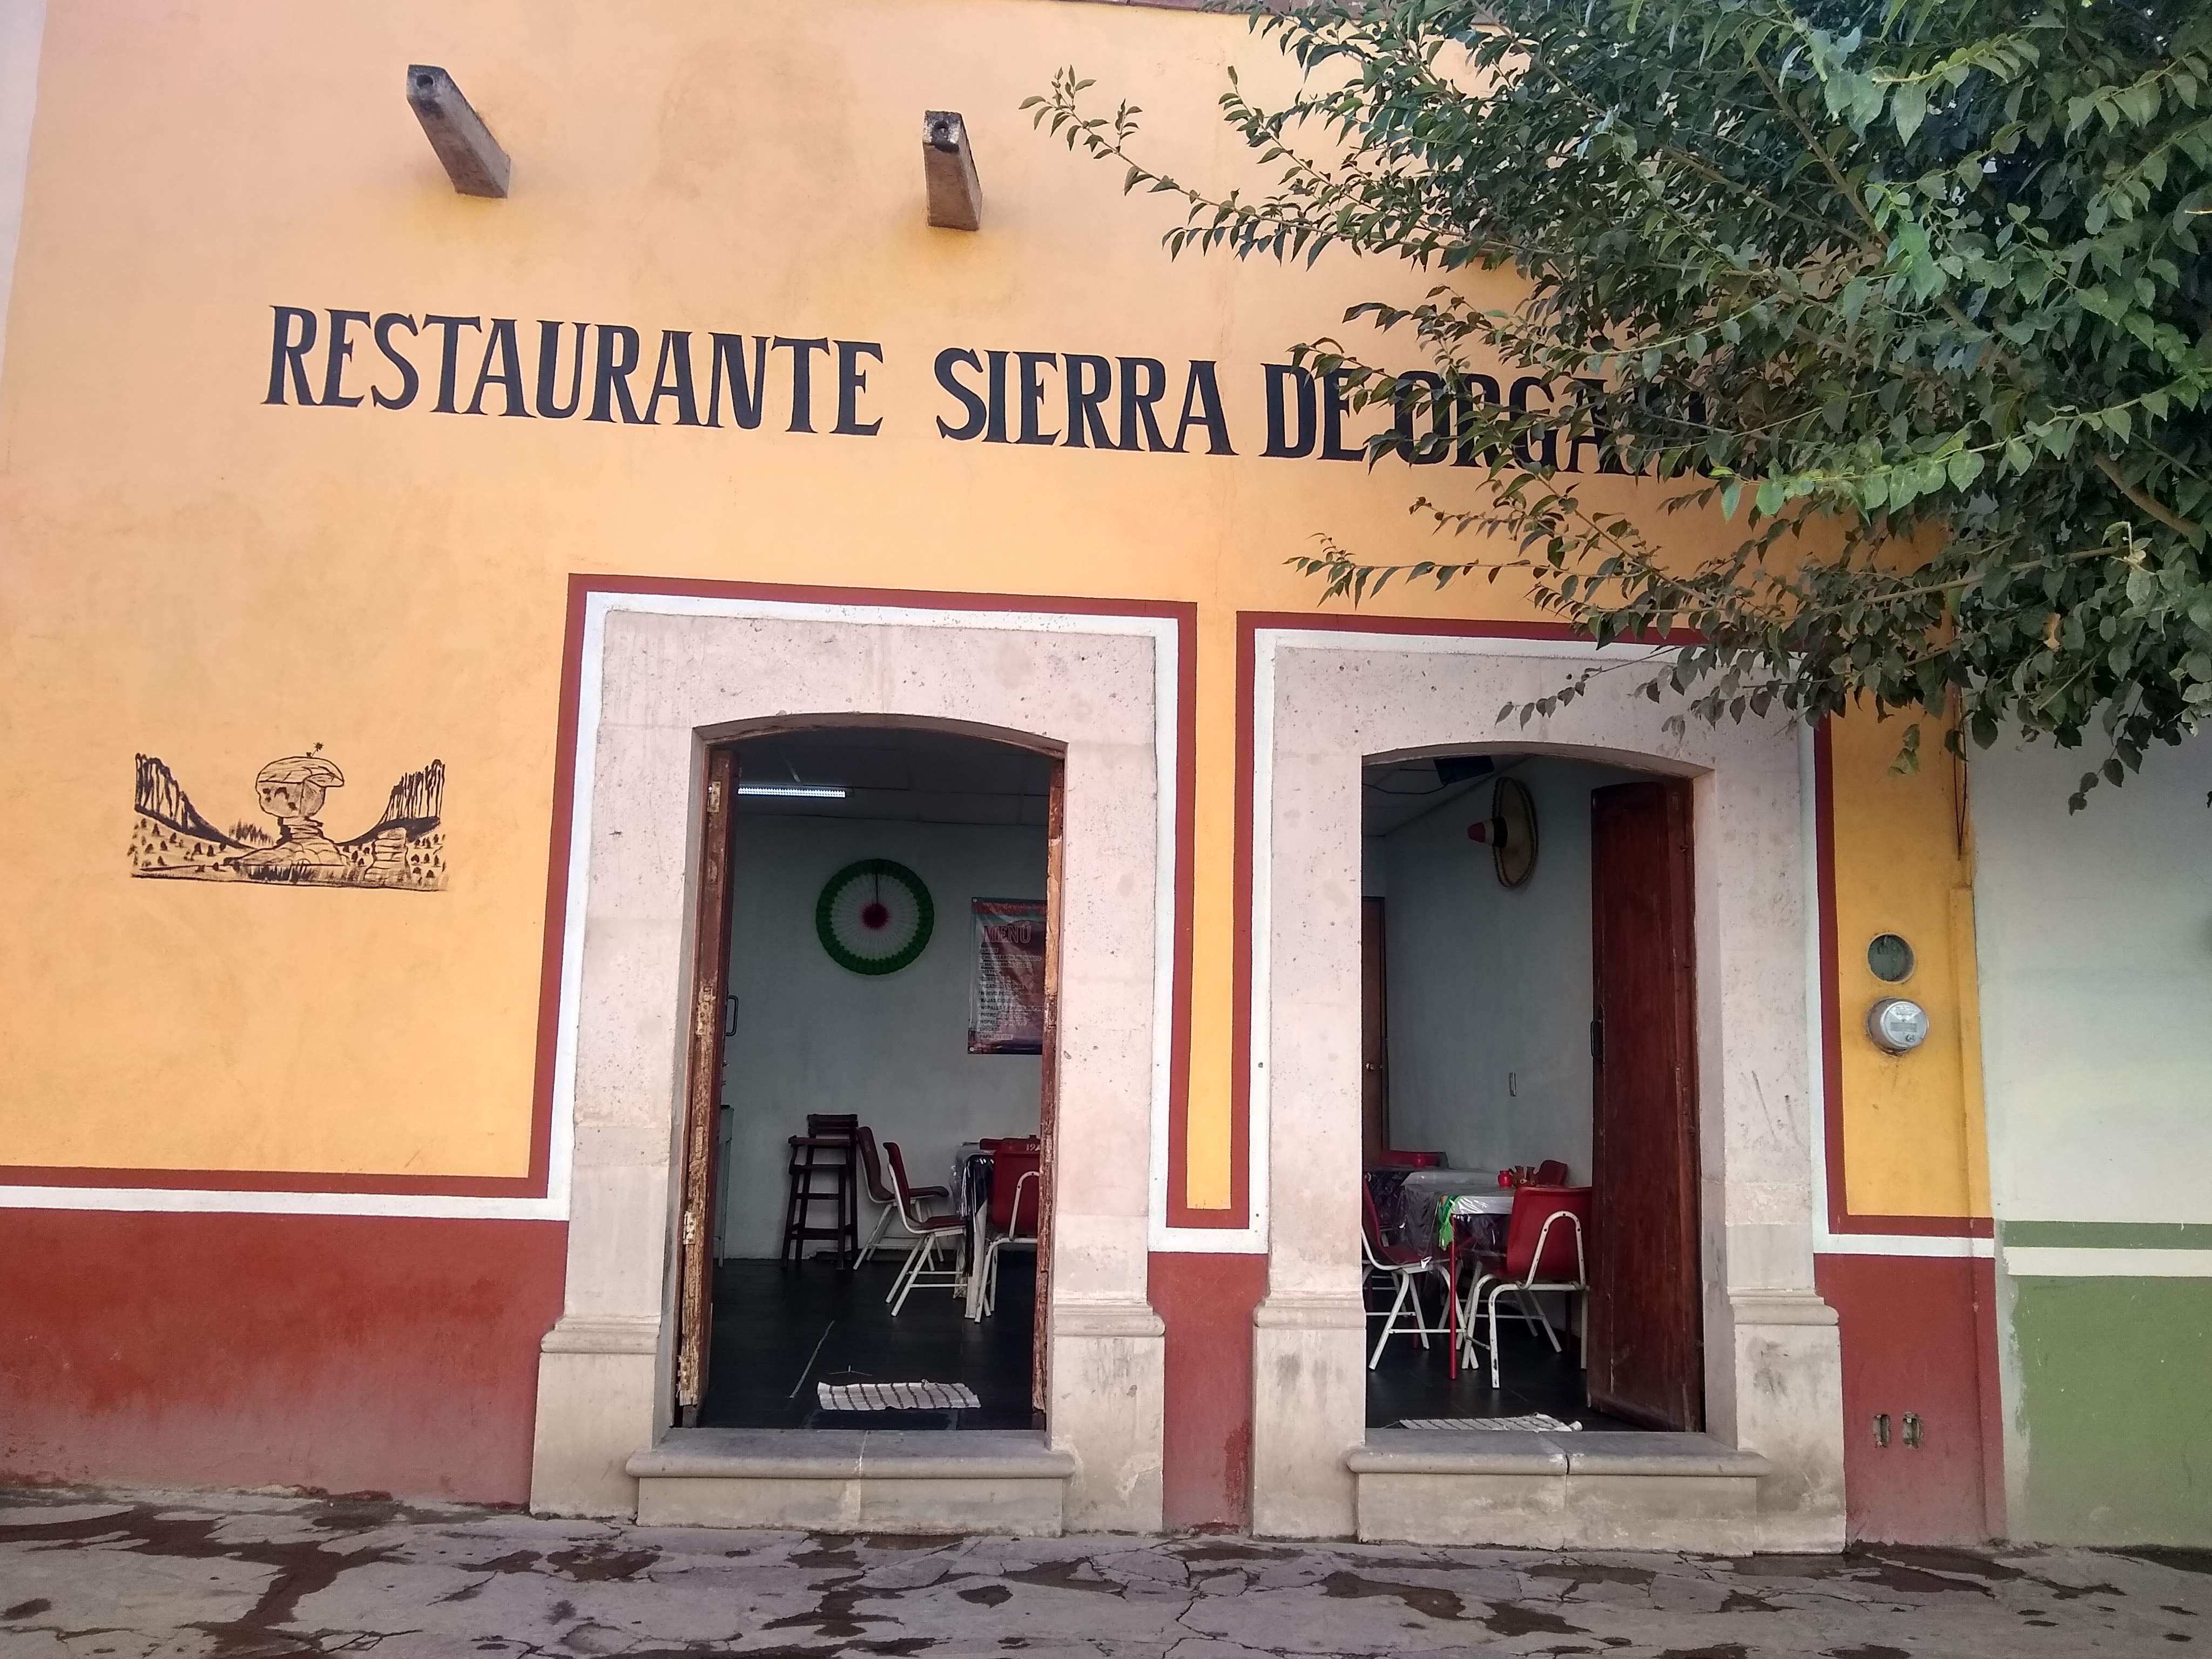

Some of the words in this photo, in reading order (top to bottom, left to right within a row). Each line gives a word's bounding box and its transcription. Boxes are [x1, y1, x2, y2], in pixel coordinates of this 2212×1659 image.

[261, 304, 884, 437] RESTAURANTE
[934, 347, 1240, 456] SIERRA
[1258, 362, 1368, 462] DE
[1393, 369, 1769, 481] ORGA
[983, 921, 1031, 943] MENÚ
